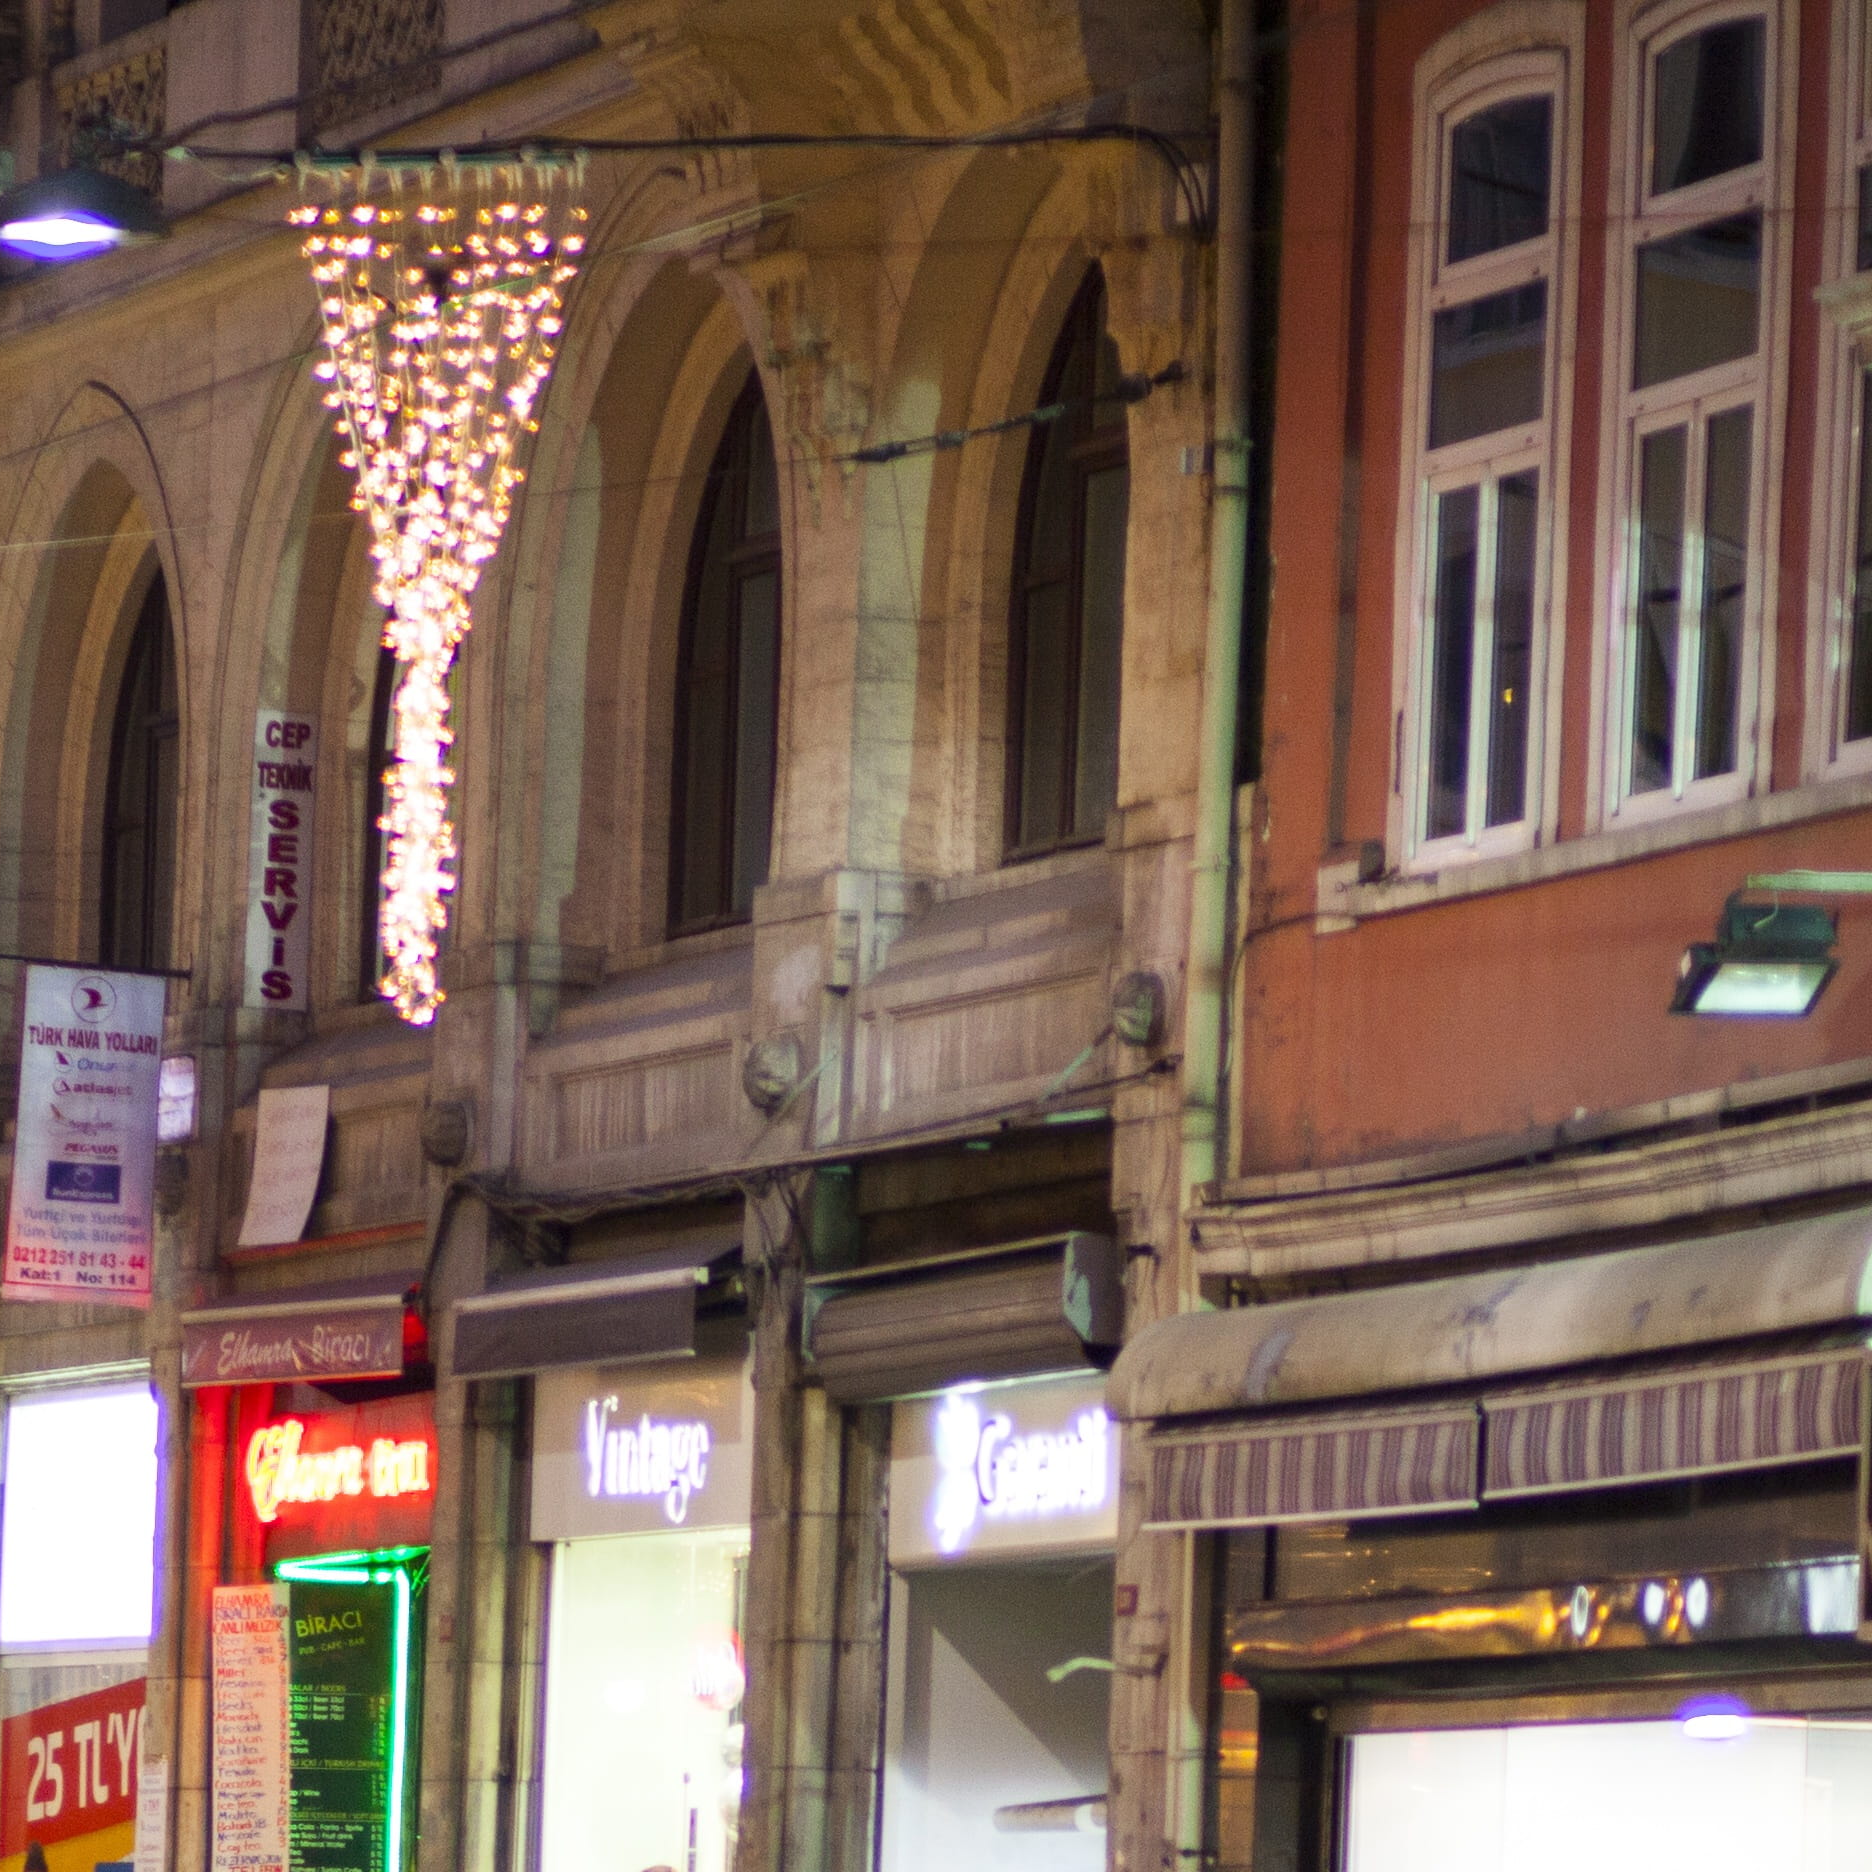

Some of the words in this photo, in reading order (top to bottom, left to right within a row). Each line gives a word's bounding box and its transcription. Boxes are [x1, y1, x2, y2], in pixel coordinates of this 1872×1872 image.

[265, 720, 311, 750] CEP
[257, 758, 314, 792] TEKNİK
[260, 799, 300, 1001] SERVİS
[28, 1022, 63, 1046] TÜRK
[67, 1028, 100, 1050] HAVA
[105, 1031, 158, 1056] YOLLARI
[13, 1246, 46, 1264] 0212
[49, 1249, 74, 1265] 251
[79, 1251, 94, 1267] 81
[99, 1253, 117, 1269] 43
[128, 1255, 145, 1270] 44
[76, 1271, 102, 1284] No:
[108, 1274, 136, 1285] 114
[588, 1395, 710, 1525] Vintage
[295, 1611, 364, 1639] BİRACI
[217, 1667, 245, 1677] Miller
[27, 1731, 64, 1822] 25
